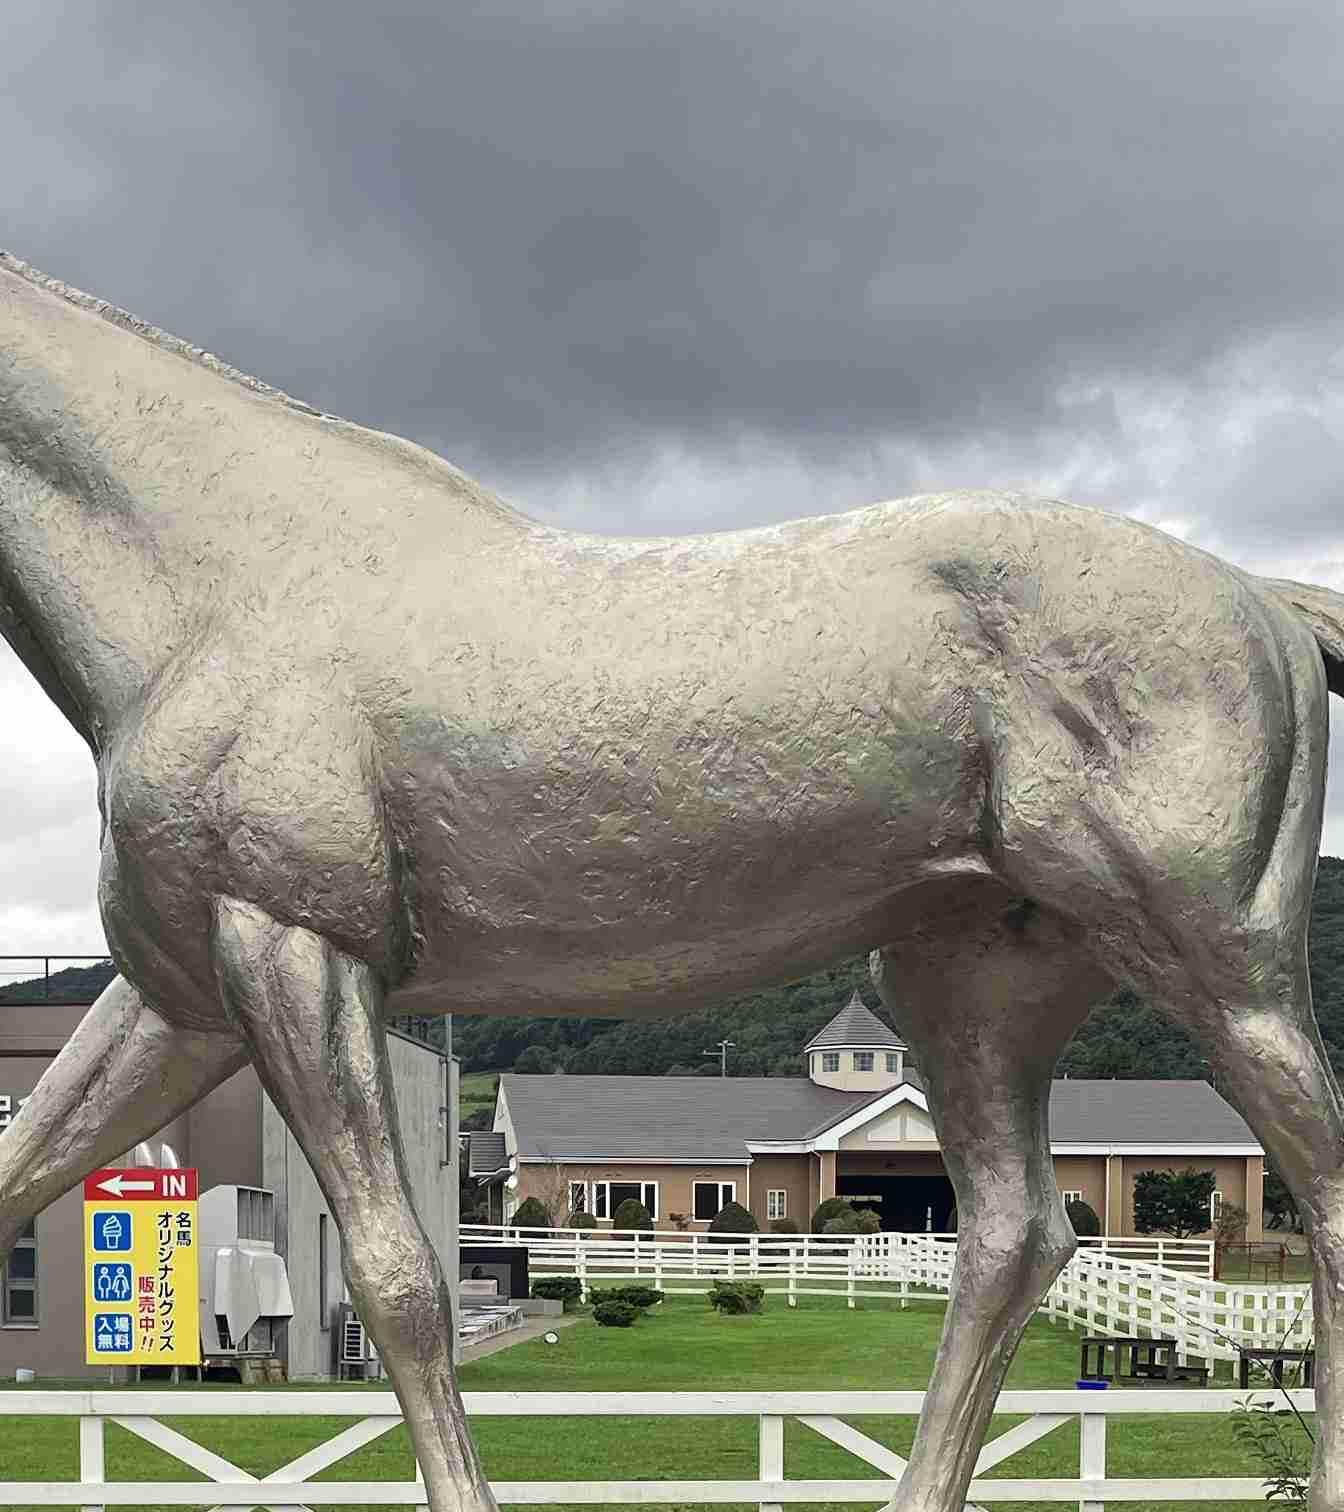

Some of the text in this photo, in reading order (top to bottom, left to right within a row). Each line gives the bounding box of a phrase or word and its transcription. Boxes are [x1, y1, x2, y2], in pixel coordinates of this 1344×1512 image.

[162, 1175, 186, 1197] IN
[175, 1212, 192, 1247] 名馬
[157, 1211, 175, 1352] オリジナルグッズ
[97, 1317, 130, 1333] 入場
[97, 1333, 131, 1349] 無料
